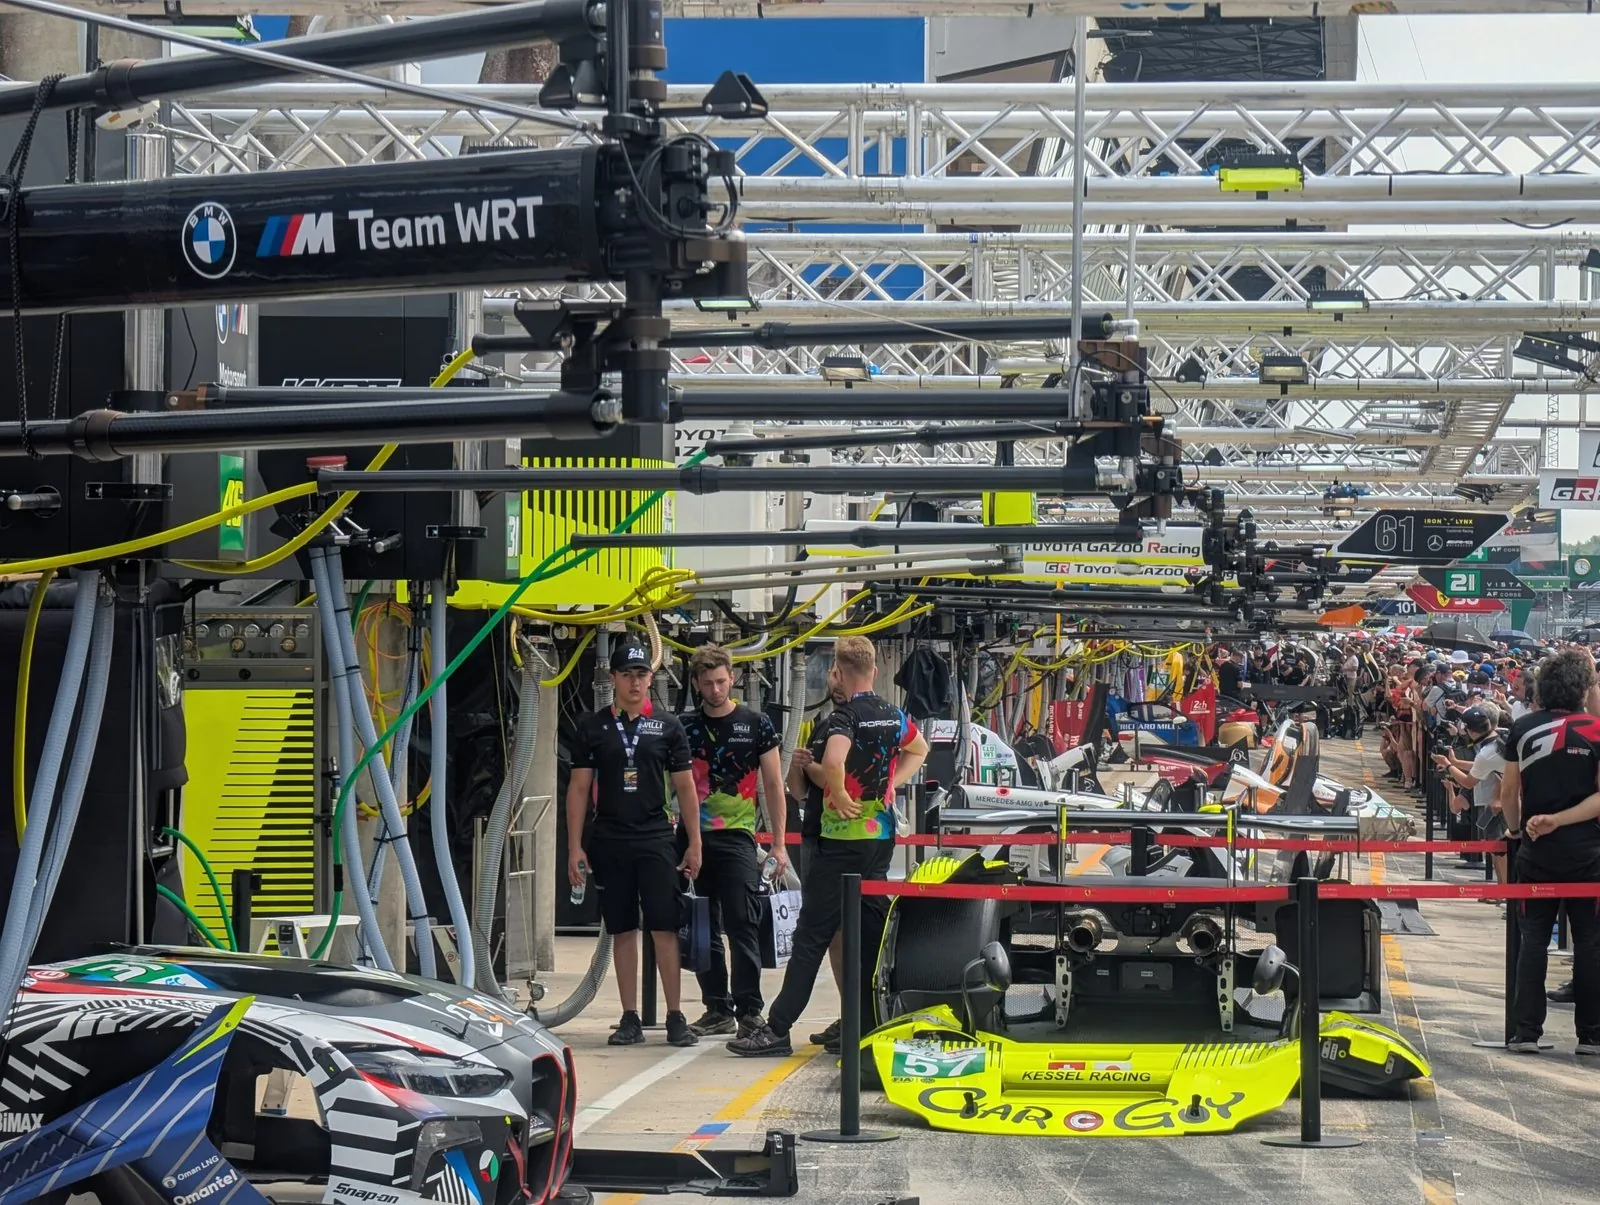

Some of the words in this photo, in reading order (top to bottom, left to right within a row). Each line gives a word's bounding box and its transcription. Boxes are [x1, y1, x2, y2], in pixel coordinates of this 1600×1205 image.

[189, 206, 228, 227] BMW
[348, 209, 446, 250] Team
[454, 196, 544, 244] WRT
[1375, 515, 1415, 552] 61
[1023, 542, 1083, 553] TOYOTA
[1086, 542, 1144, 553] GAZOO
[1147, 542, 1201, 557] Racing
[1074, 564, 1118, 574] TOYO
[1139, 567, 1183, 577] AZOO
[1450, 574, 1475, 592] 21
[1396, 601, 1417, 614] 101
[858, 720, 901, 728] PORSCHE
[976, 796, 1033, 807] MERCEDES-AMG
[903, 1054, 978, 1076] 57
[1021, 1070, 1084, 1082] KESSEL
[1089, 1071, 1152, 1083] RACING
[177, 1165, 201, 1181] Oman
[201, 1155, 219, 1169] LNG
[173, 1169, 239, 1205] Omantel
[332, 1182, 400, 1204] Snap-on
